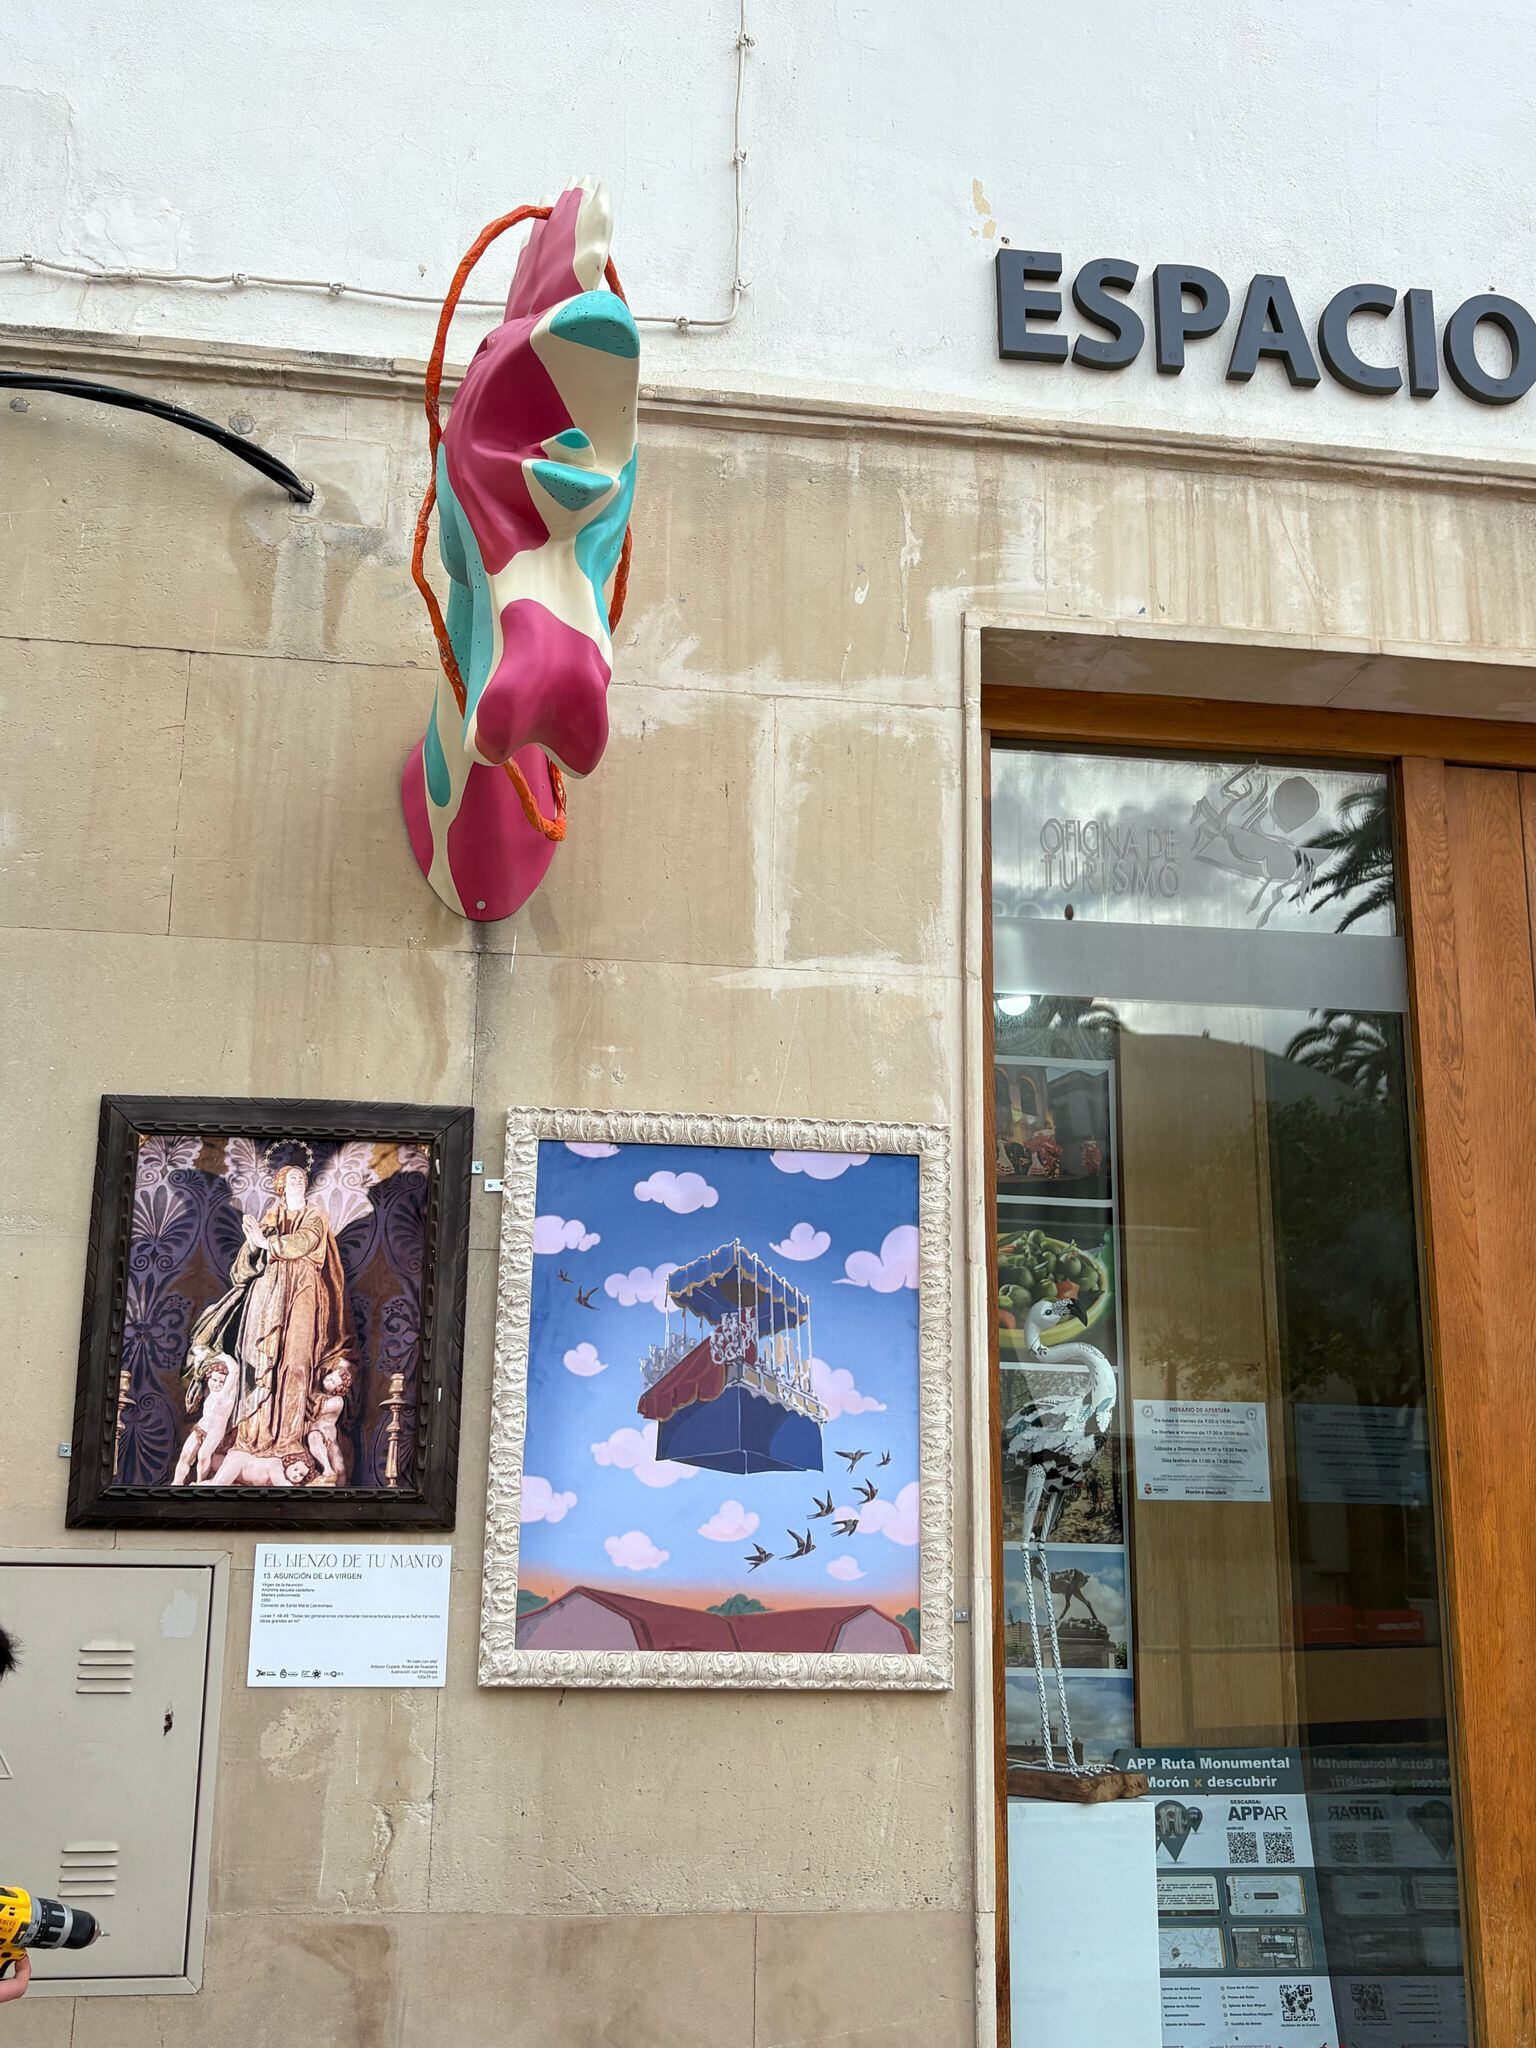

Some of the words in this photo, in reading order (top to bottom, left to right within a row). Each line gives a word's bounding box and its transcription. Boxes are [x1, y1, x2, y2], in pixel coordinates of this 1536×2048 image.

[995, 248, 1536, 405] ESPACIO
[1040, 818, 1143, 859] OFICINA
[1147, 825, 1179, 861] DE
[1040, 854, 1183, 898] TURISMO
[264, 1553, 281, 1567] EL
[286, 1553, 337, 1567] LIENZO
[342, 1553, 362, 1568] DE
[366, 1553, 386, 1568] TU
[390, 1553, 443, 1568] MANTO
[273, 1572, 311, 1580] ASUNCIÓN
[1127, 1758, 1156, 1770] APP
[1161, 1758, 1195, 1769] Ruta
[1200, 1757, 1290, 1769] Monumental
[1148, 1774, 1189, 1788] Morón
[1194, 1777, 1202, 1788] x
[1207, 1775, 1277, 1787] descubrir
[1228, 1806, 1287, 1821] APPAR
